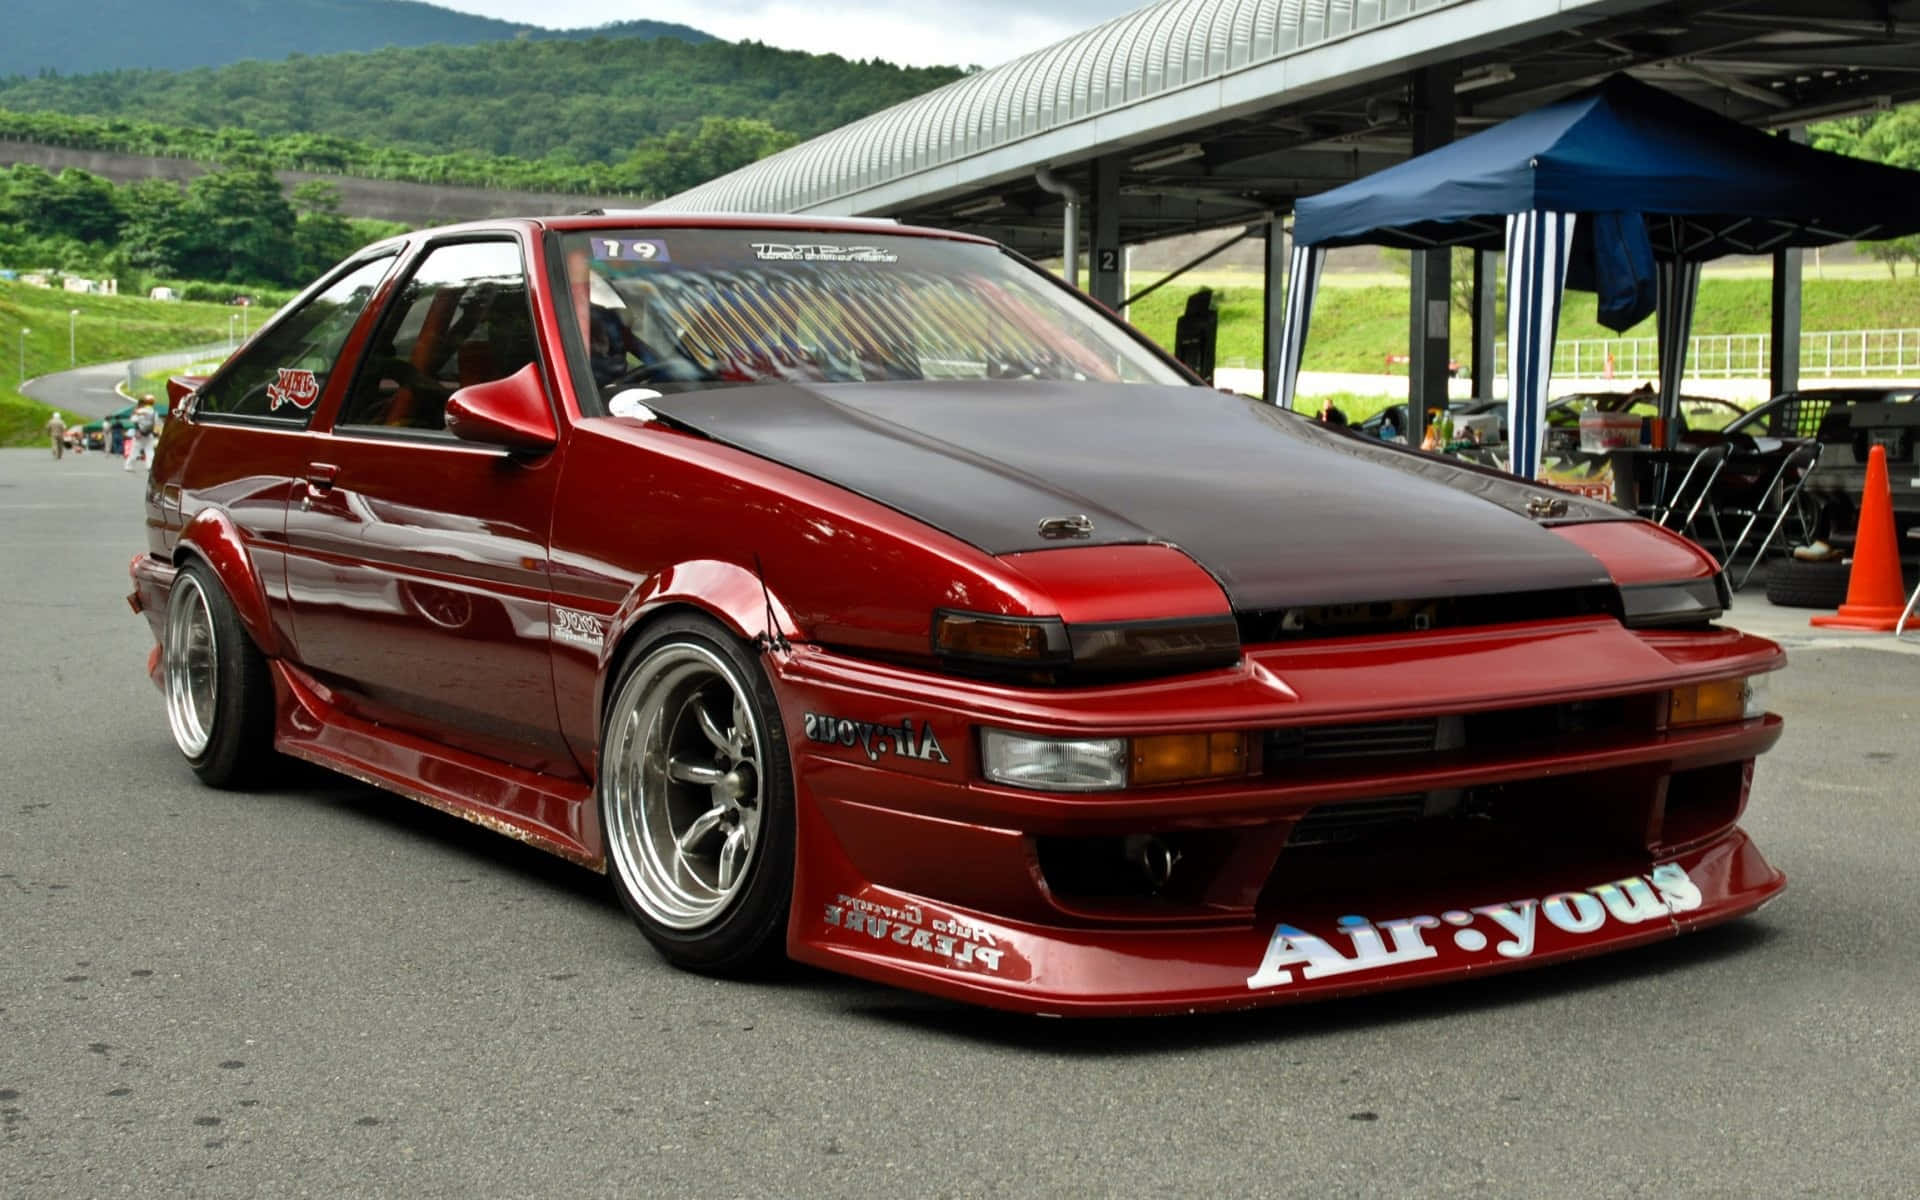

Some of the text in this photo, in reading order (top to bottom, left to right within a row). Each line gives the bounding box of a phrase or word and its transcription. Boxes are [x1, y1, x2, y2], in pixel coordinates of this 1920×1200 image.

[602, 240, 656, 259] 19
[1103, 252, 1114, 270] 2
[1246, 862, 1702, 989] Air:yous
